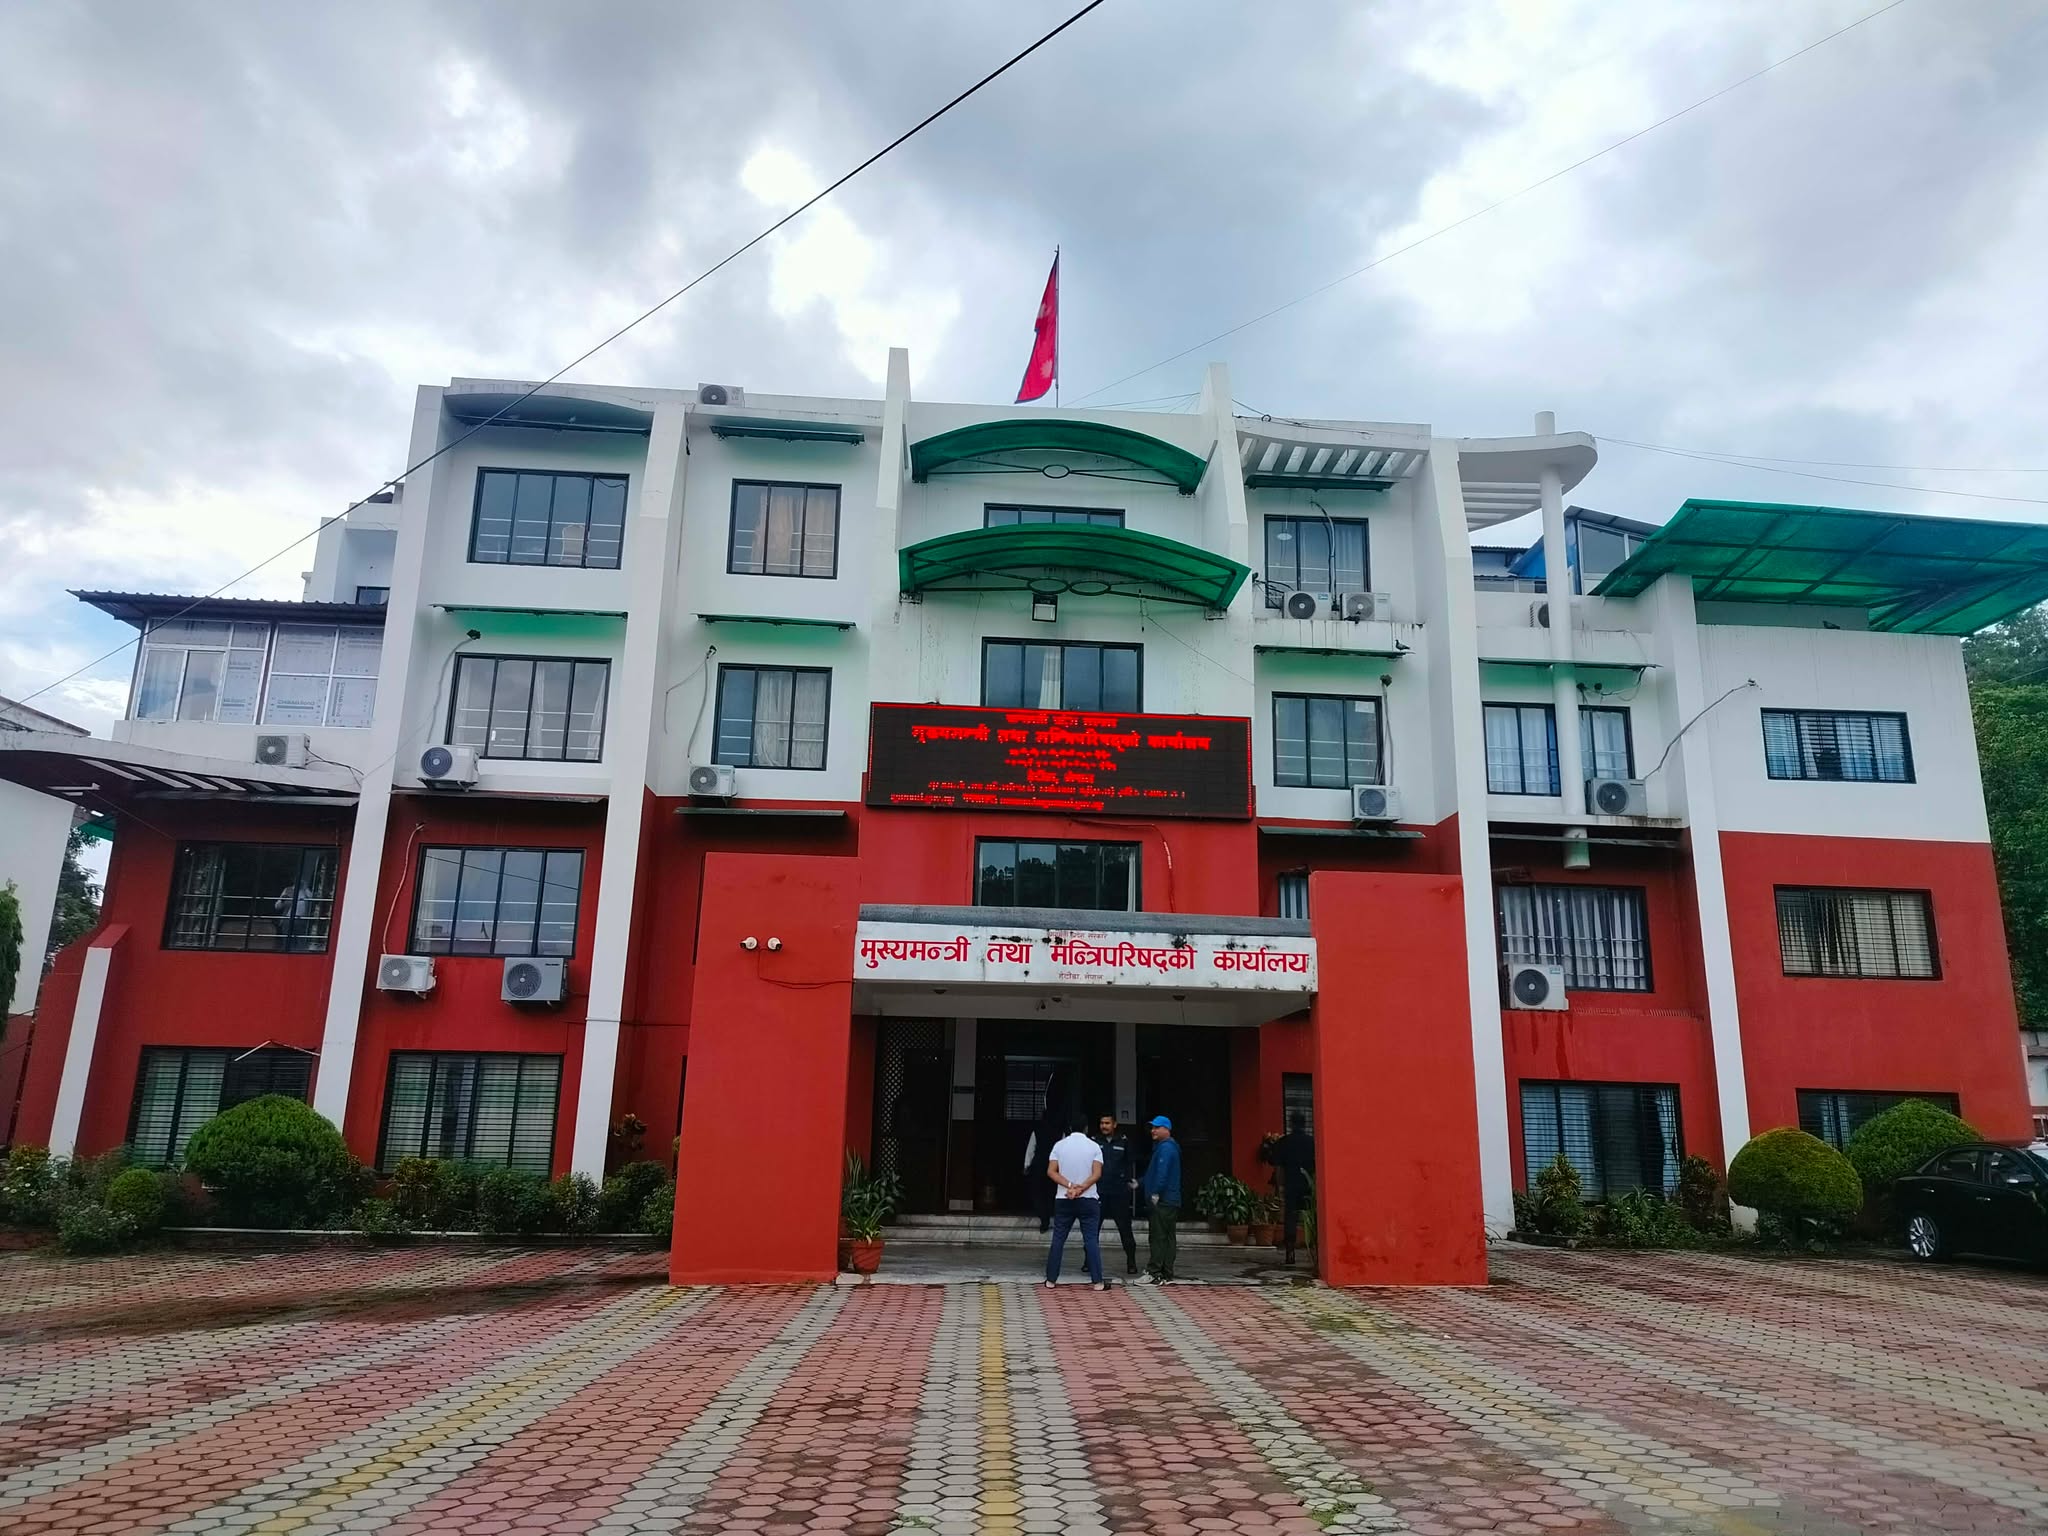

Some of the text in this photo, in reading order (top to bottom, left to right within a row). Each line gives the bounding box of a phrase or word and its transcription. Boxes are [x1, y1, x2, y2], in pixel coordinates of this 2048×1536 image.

[860, 935, 972, 969] मुख्यमन्त्री
[986, 942, 1034, 965] तथा
[1213, 946, 1310, 974] कार्यालय
